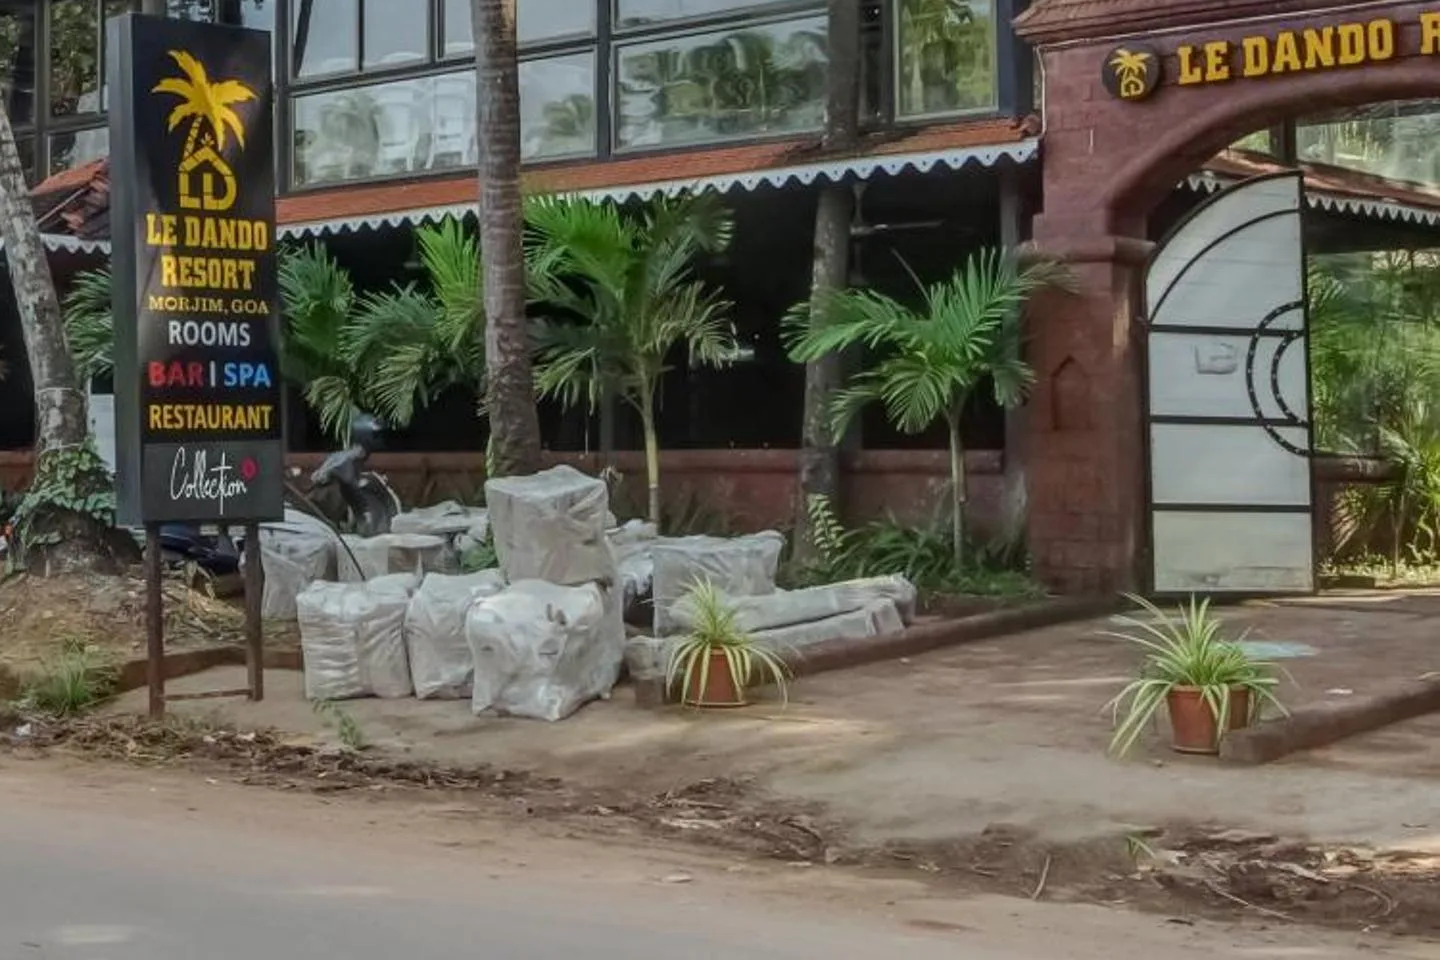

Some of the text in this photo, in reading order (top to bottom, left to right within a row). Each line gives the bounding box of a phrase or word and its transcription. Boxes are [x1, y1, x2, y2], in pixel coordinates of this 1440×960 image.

[1177, 41, 1231, 85] LE
[1243, 18, 1394, 78] DANDO
[146, 213, 268, 251] LE DANDO
[160, 255, 255, 290] RESORT
[148, 295, 270, 315] MORJIM, GOA
[168, 320, 251, 347] ROOMS
[148, 360, 204, 387] BAR
[224, 362, 271, 388] SPA
[149, 404, 273, 431] RESTAURANT
[170, 445, 247, 516] Collection
